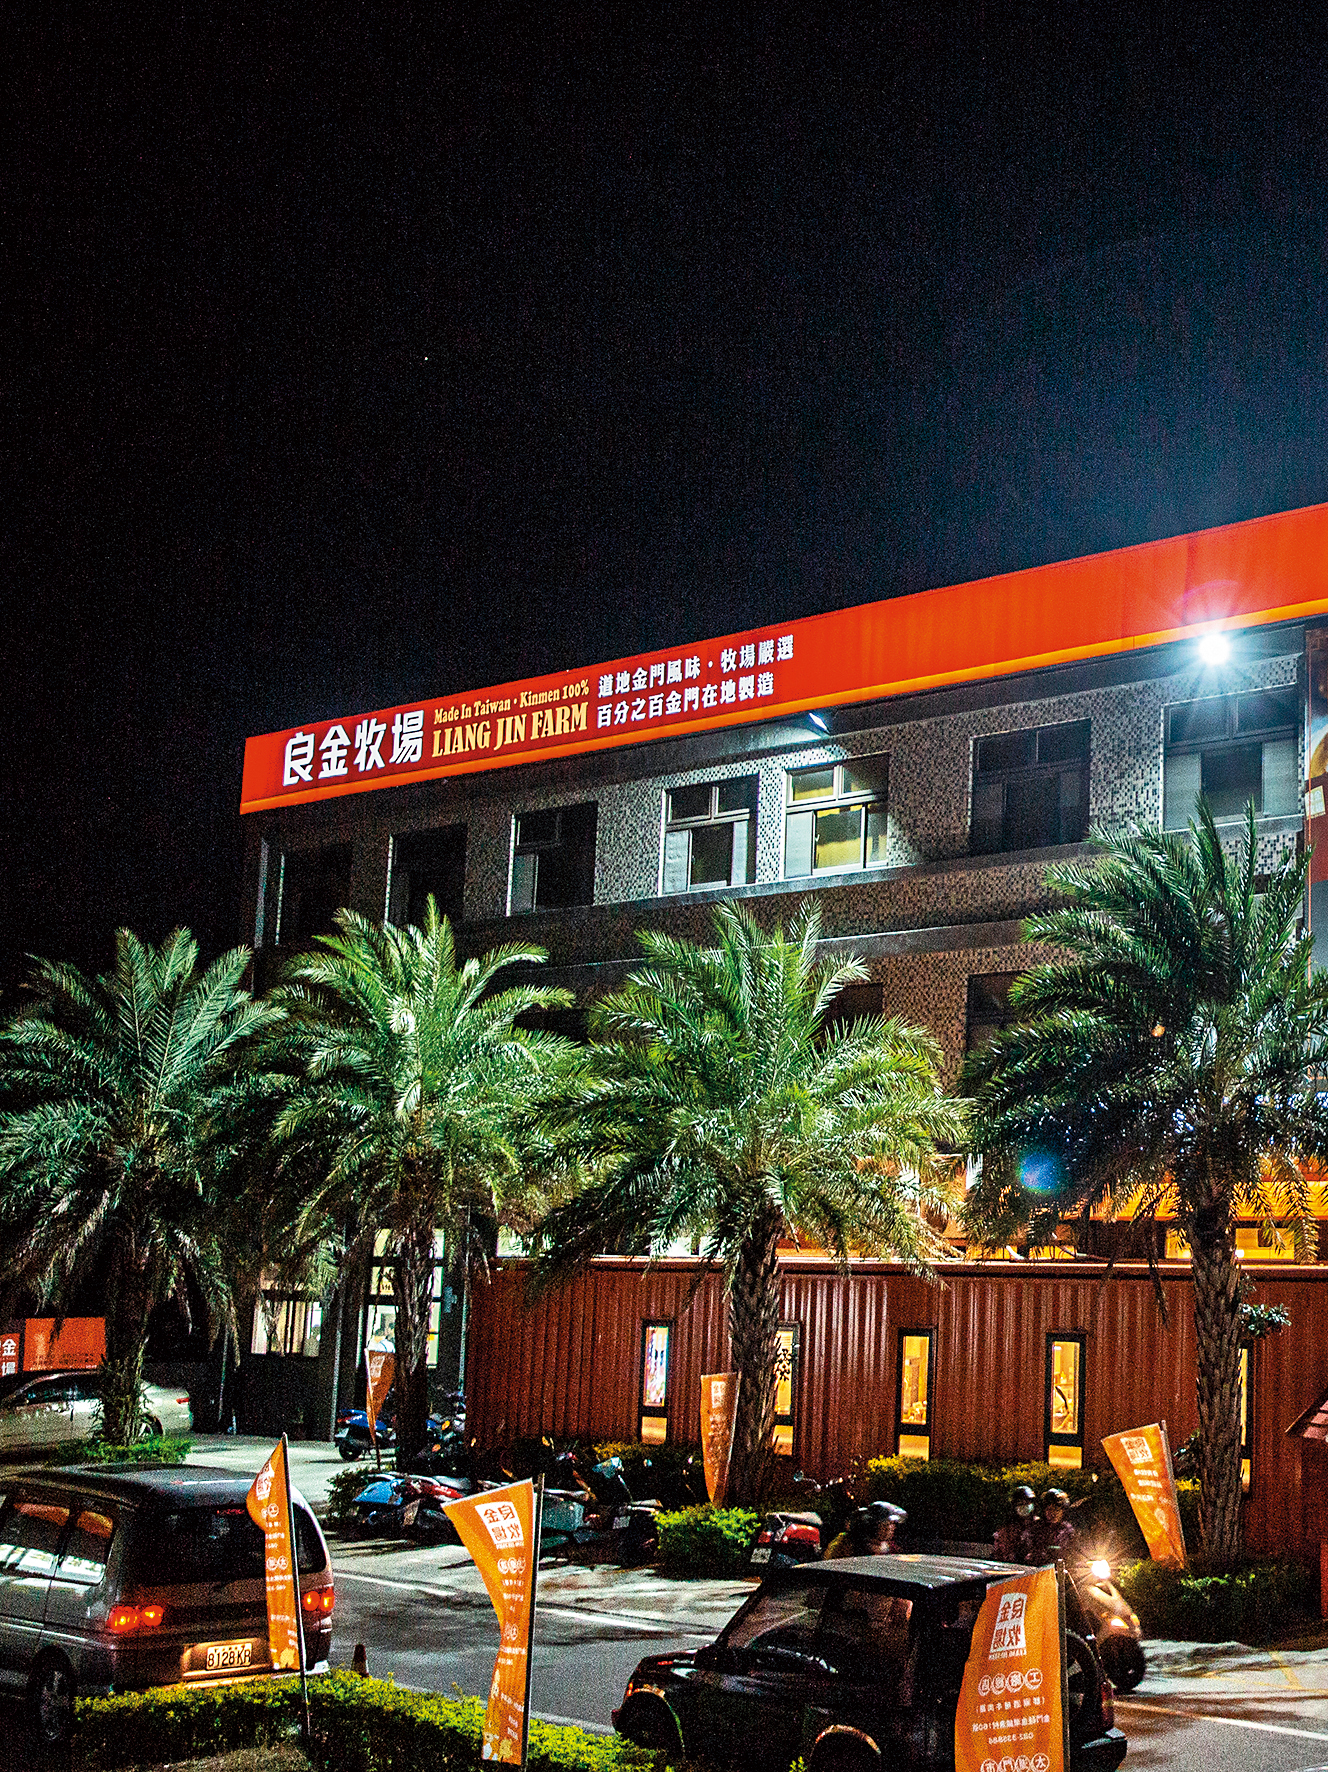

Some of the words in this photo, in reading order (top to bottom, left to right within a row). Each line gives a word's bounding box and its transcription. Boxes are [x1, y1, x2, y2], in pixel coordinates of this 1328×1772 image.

[434, 704, 459, 725] Made
[460, 702, 472, 720] In
[473, 695, 511, 717] Taiwan
[519, 688, 560, 708] Kinmen
[562, 679, 590, 701] 100%
[596, 670, 775, 729] 百分之百金門在地製造
[282, 709, 424, 787] 良金牧場
[431, 718, 491, 757] LIANG
[493, 713, 527, 750] JIN
[530, 702, 589, 742] FARM
[0, 1338, 17, 1356] 金
